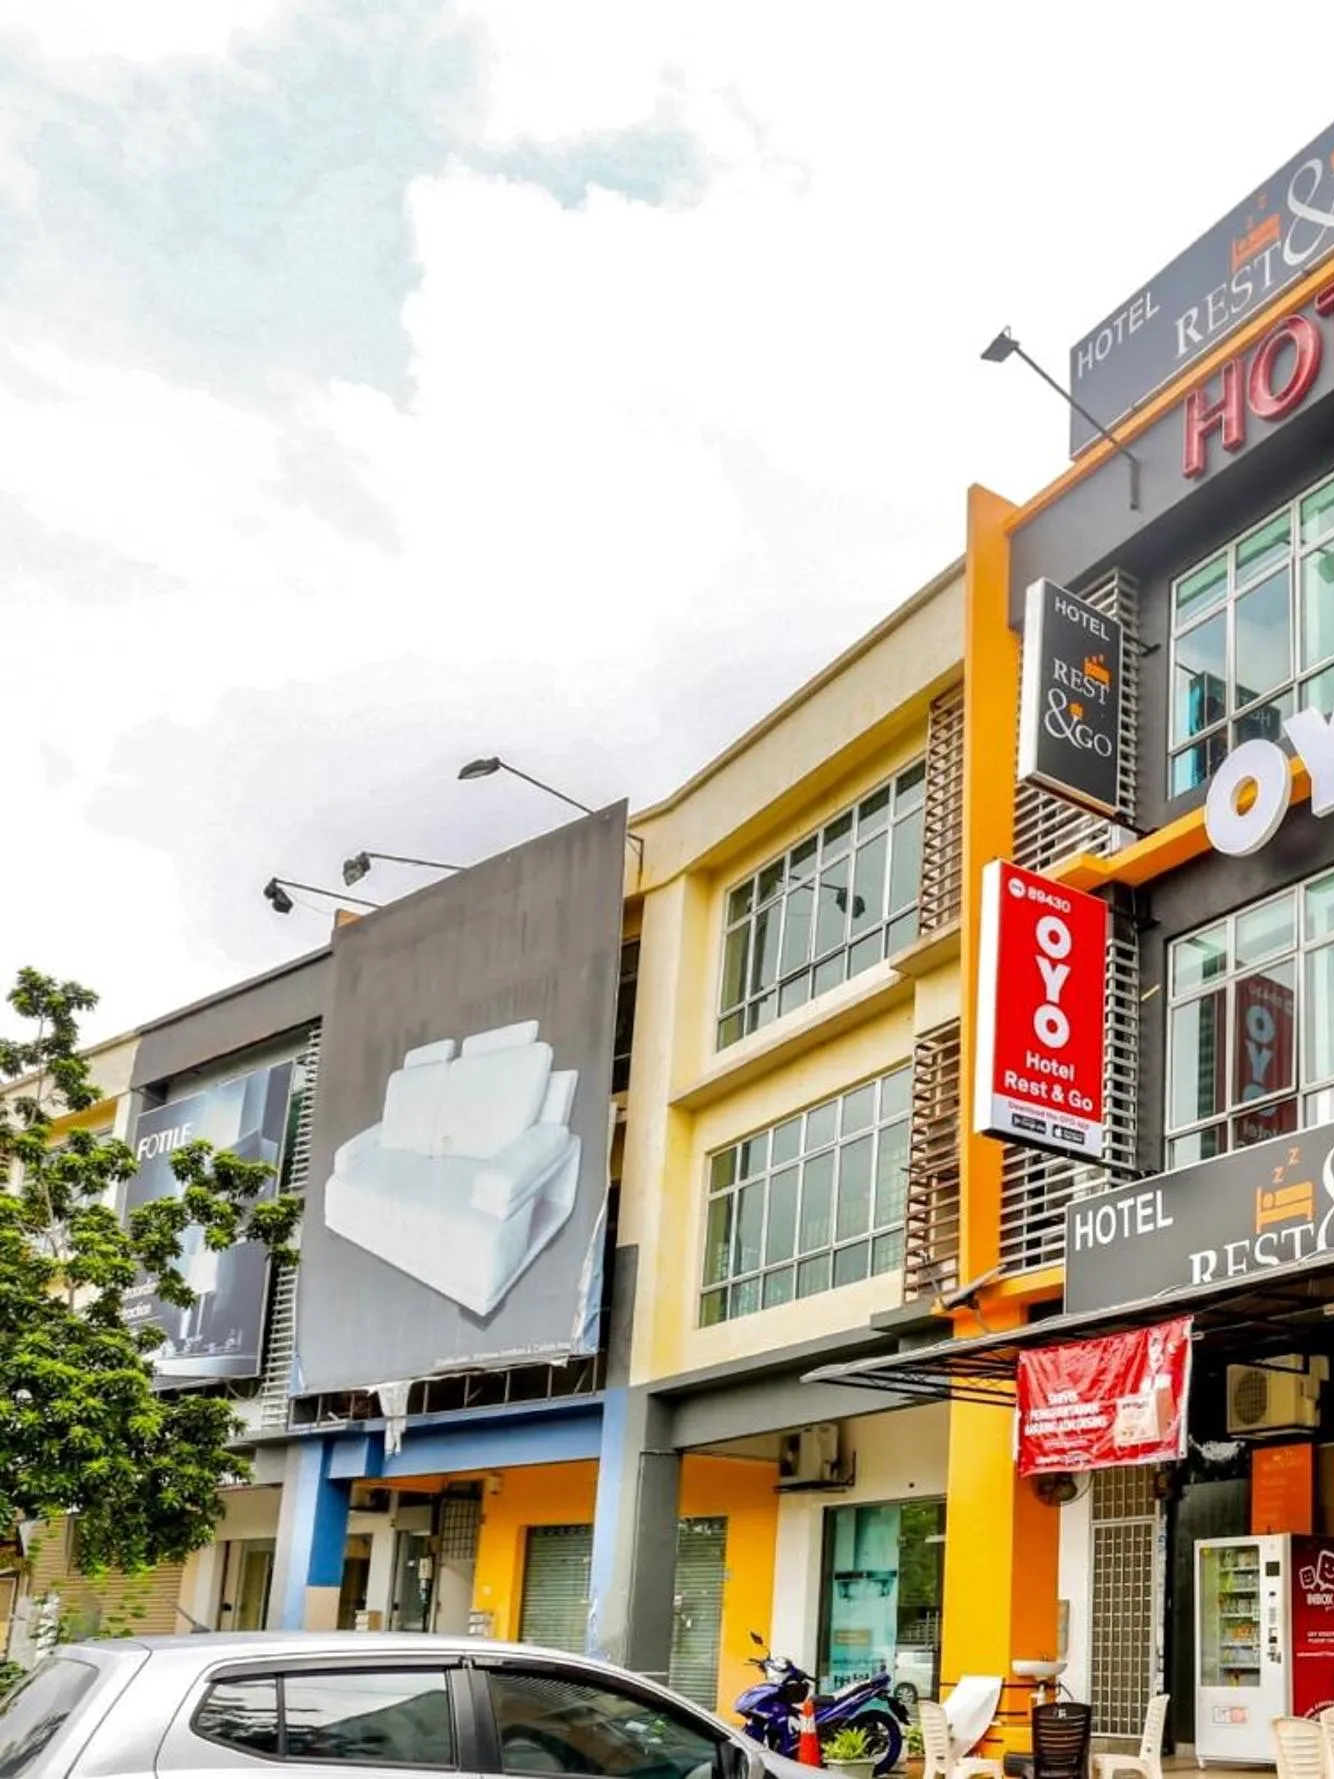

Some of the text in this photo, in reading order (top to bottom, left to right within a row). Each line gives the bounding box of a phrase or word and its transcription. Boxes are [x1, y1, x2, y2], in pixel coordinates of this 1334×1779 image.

[1076, 291, 1160, 379] HOTEL
[1054, 596, 1111, 642] HOTEL
[1053, 656, 1110, 706] REST
[1034, 915, 1072, 1049] OYO
[1026, 1049, 1075, 1082] Hotel
[1004, 1069, 1094, 1112] Rest & Go
[137, 1122, 195, 1161] FOTILE
[1074, 1190, 1174, 1251] HOTEL
